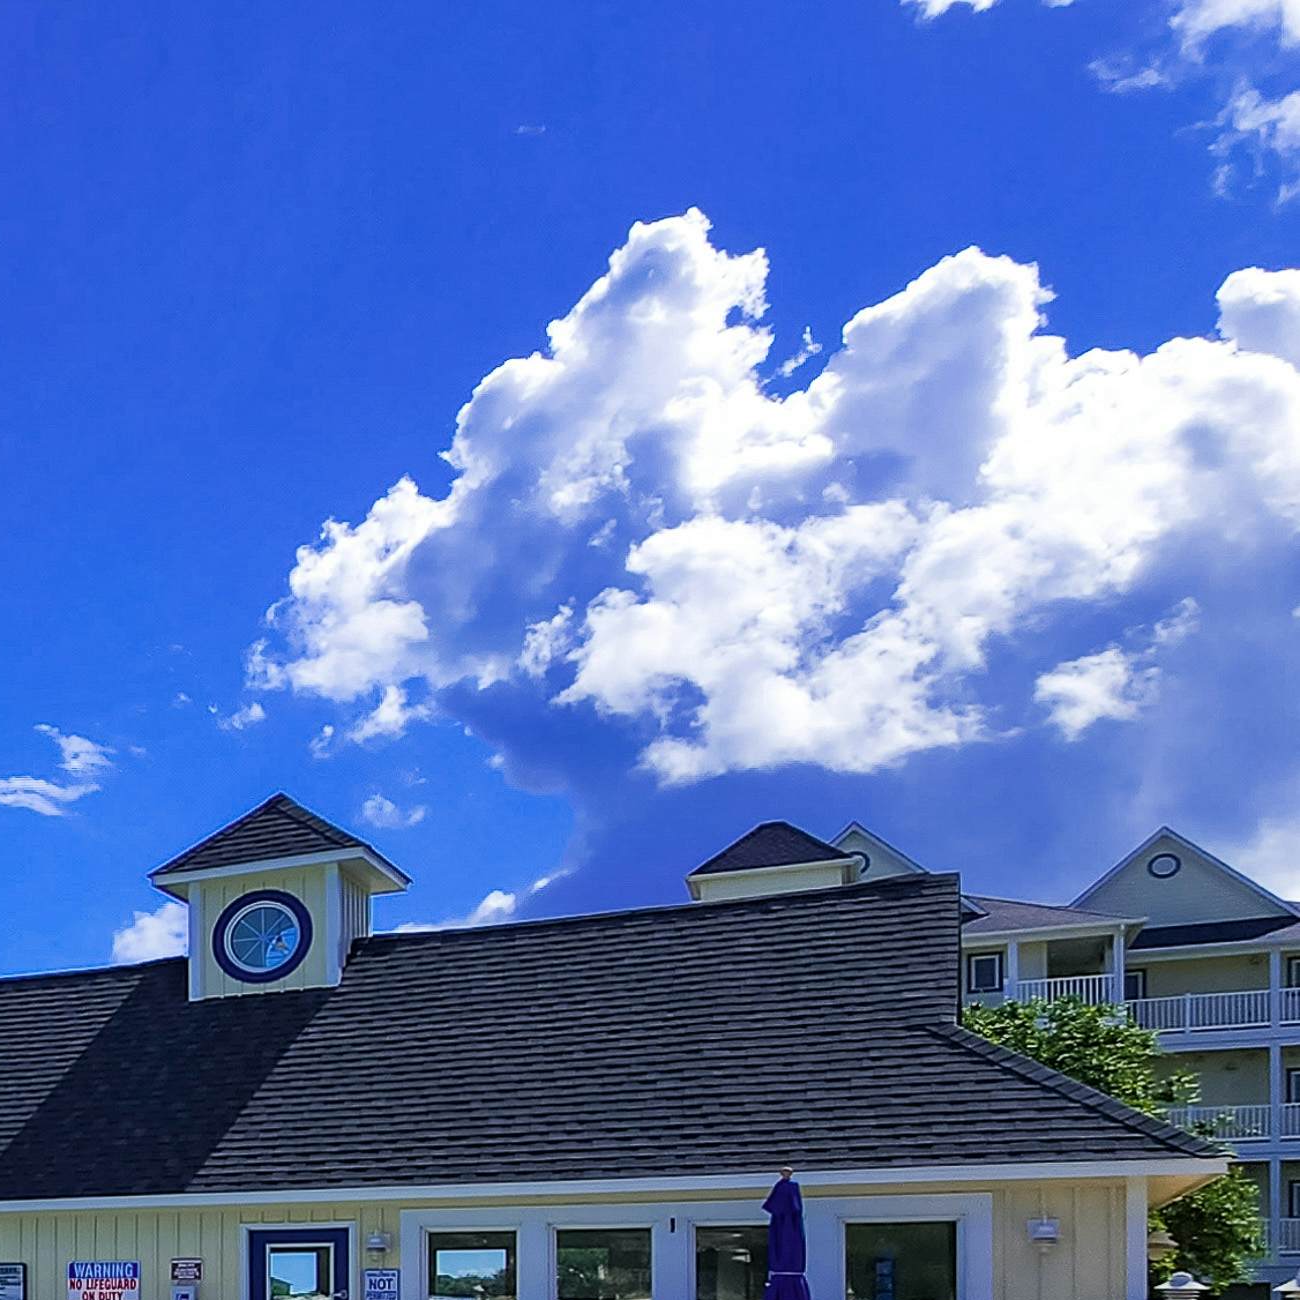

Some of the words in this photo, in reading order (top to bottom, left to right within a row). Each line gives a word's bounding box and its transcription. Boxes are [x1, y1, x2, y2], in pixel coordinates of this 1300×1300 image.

[74, 1263, 133, 1277] WARNING
[69, 1279, 82, 1290] NO
[87, 1279, 136, 1290] LIFEGUARD
[369, 1278, 393, 1290] NOT
